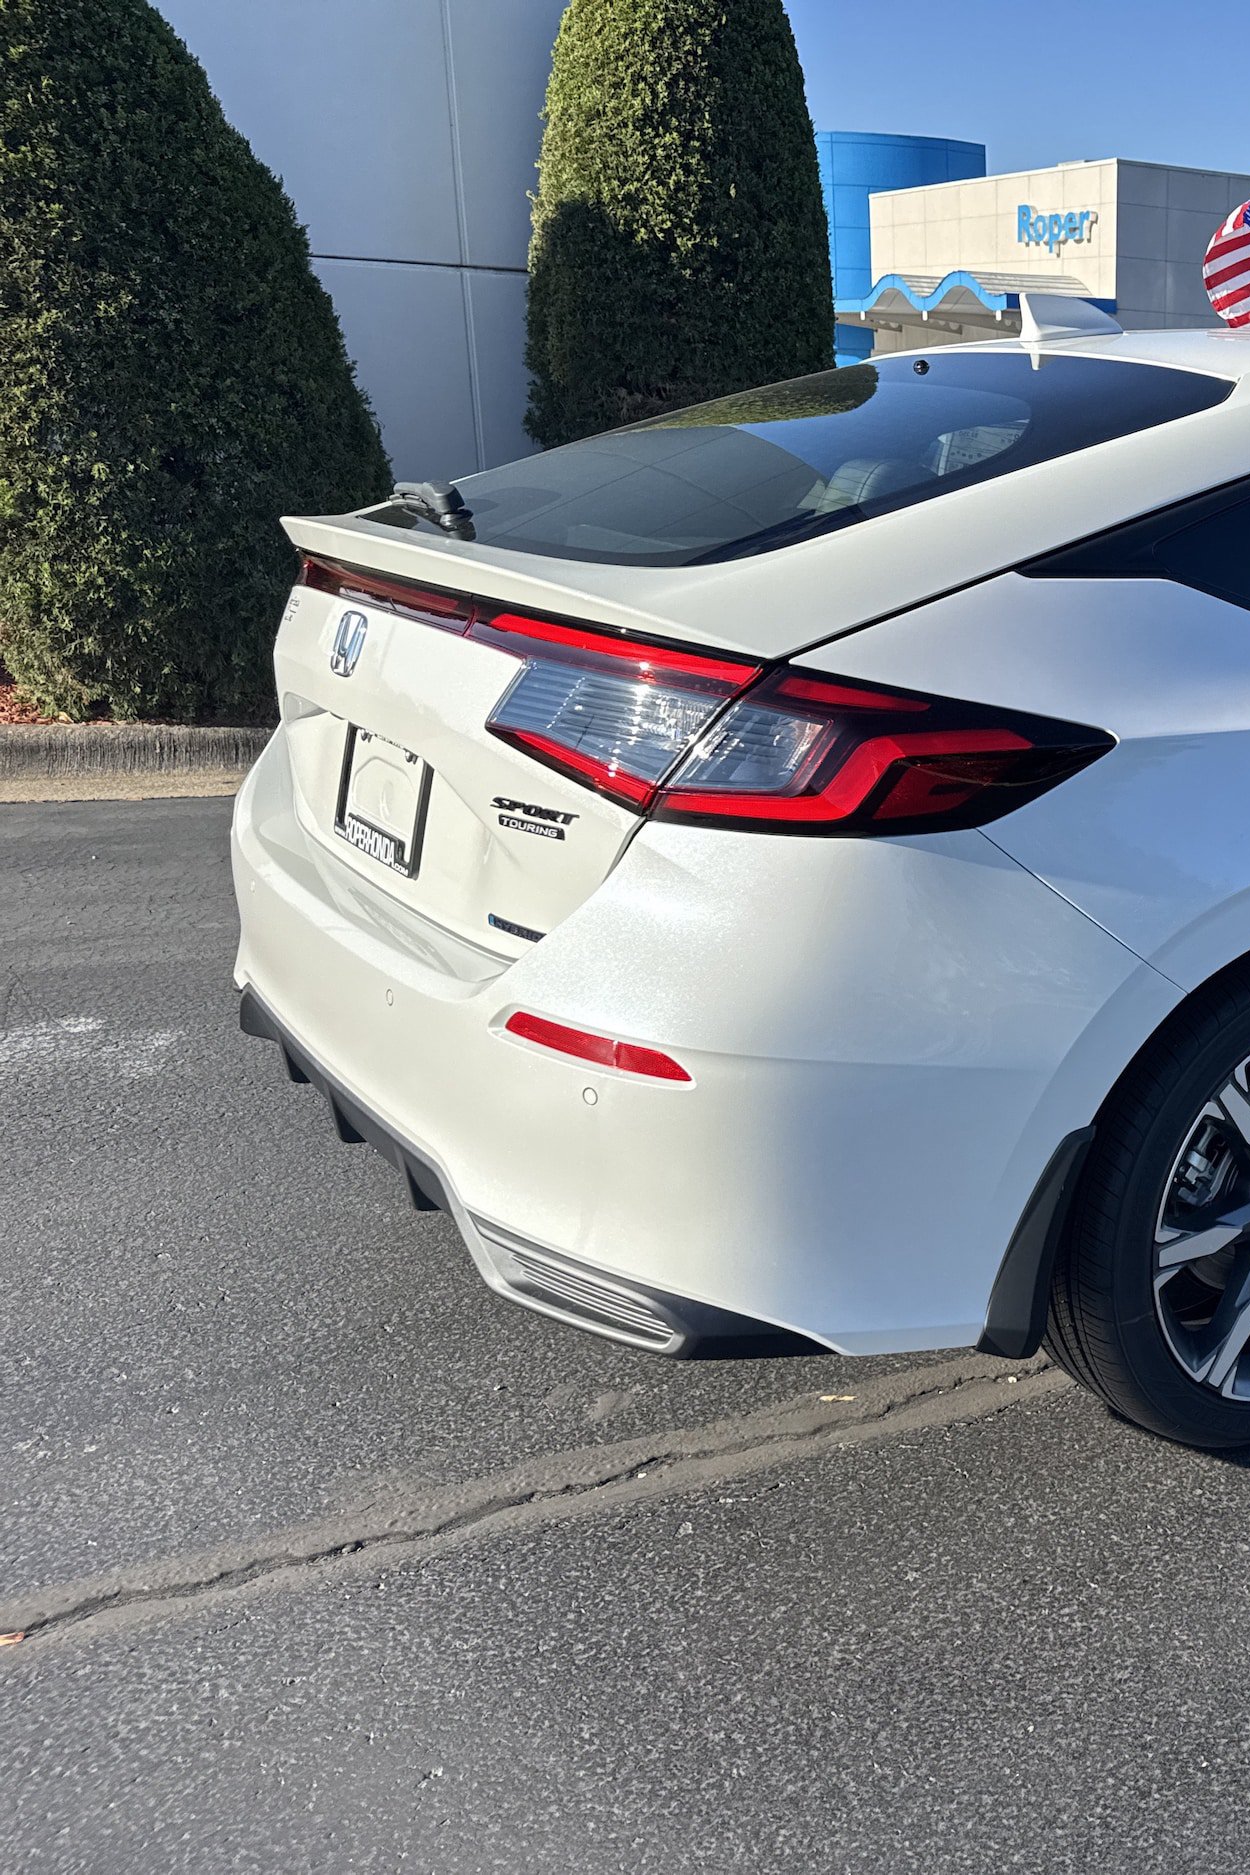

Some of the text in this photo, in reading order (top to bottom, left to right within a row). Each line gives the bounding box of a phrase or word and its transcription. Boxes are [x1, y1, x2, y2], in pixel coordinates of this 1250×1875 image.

[1017, 204, 1091, 253] Roper
[490, 797, 580, 826] SPORT
[501, 816, 559, 838] TOURING
